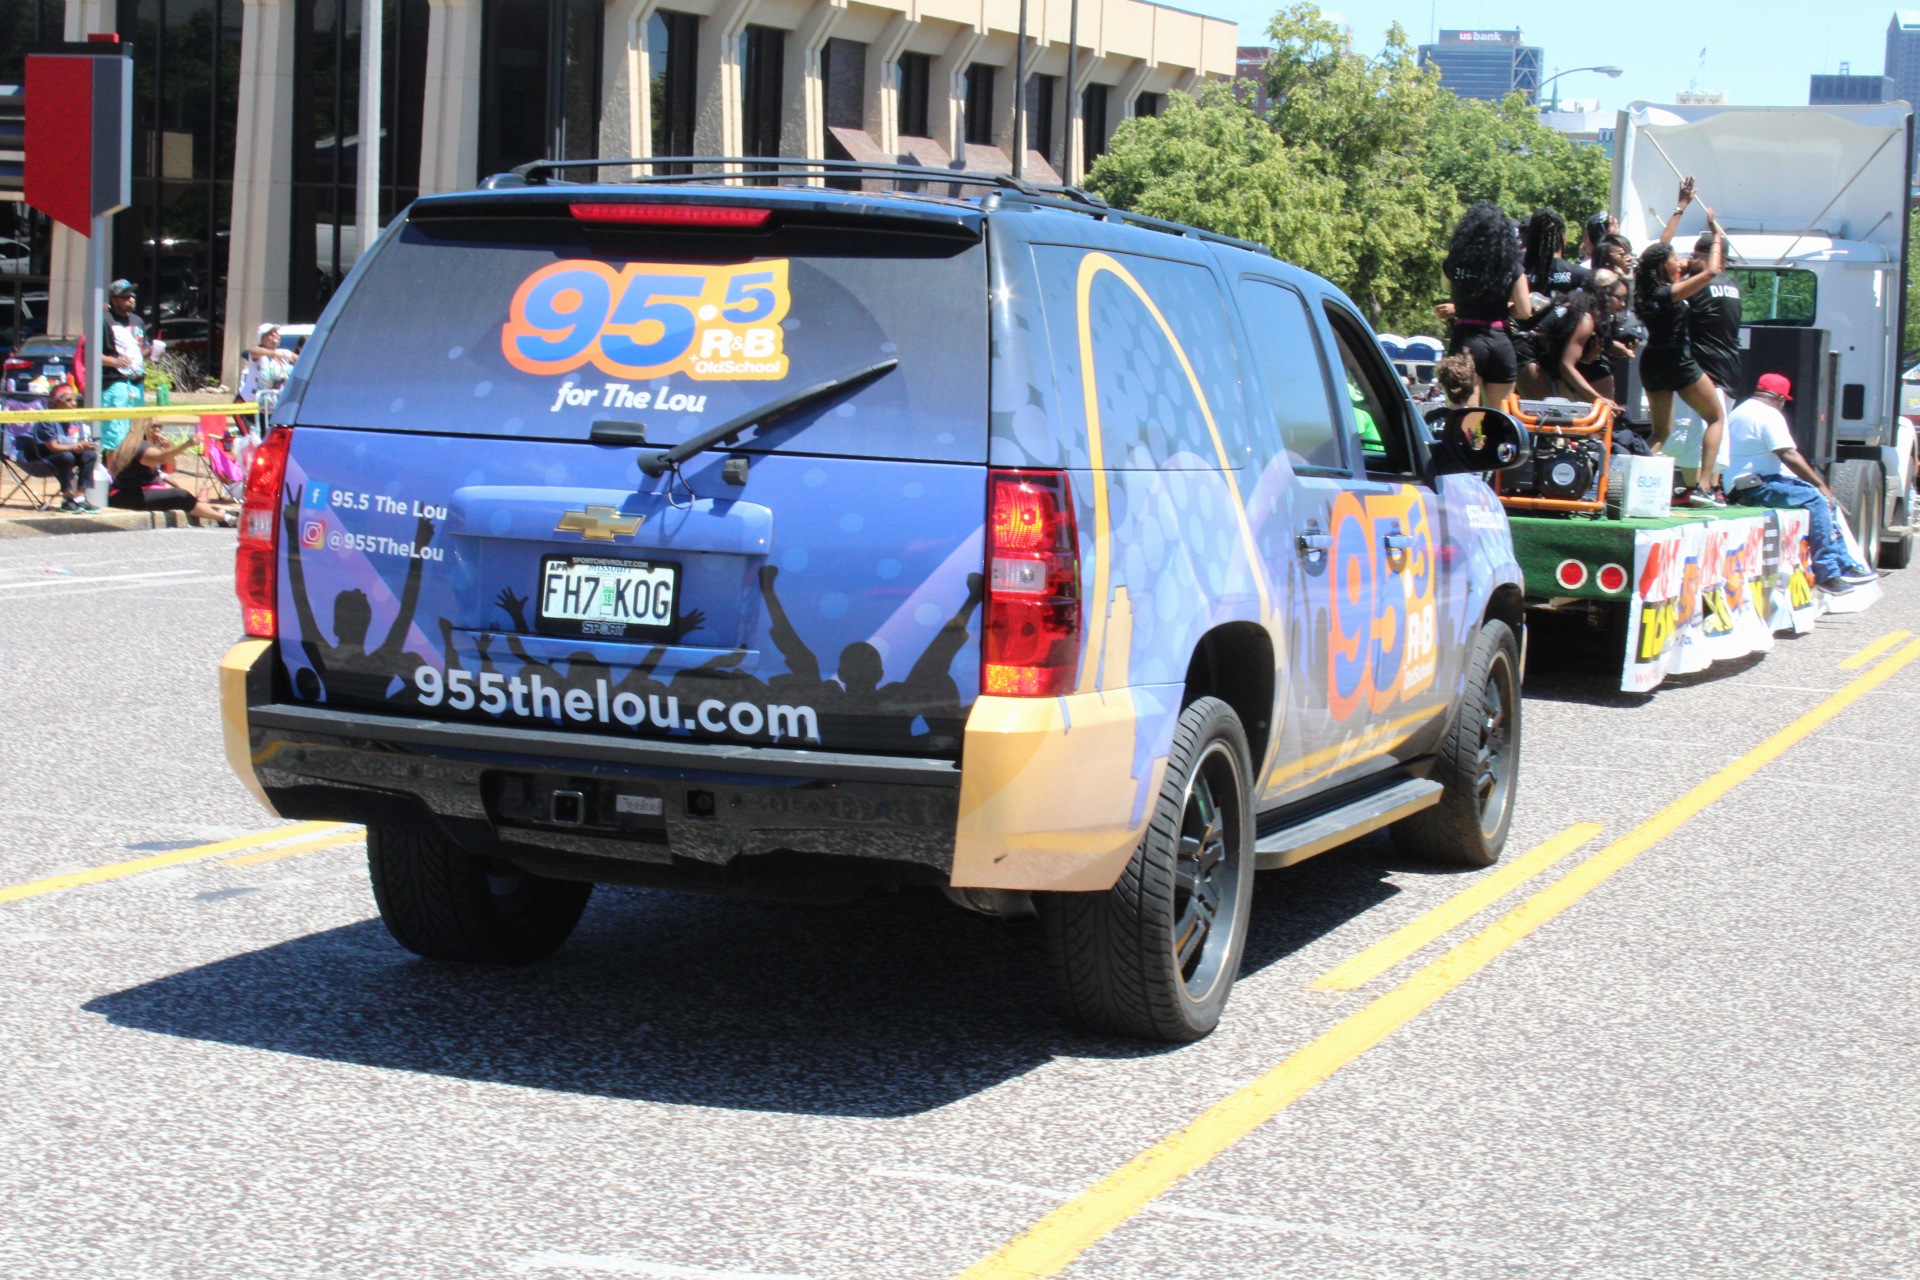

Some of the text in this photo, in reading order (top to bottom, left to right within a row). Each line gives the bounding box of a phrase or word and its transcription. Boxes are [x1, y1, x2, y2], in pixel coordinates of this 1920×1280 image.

[1709, 285, 1724, 298] DJ
[699, 327, 777, 359] R&B
[550, 381, 708, 413] for The Lou
[331, 490, 370, 511] 95.5
[375, 495, 408, 515] The
[412, 500, 448, 521] Lou
[326, 530, 444, 562] @955TheLou
[549, 562, 568, 572] APR
[544, 574, 601, 616] FH7
[414, 664, 819, 739] 955thelou.com
